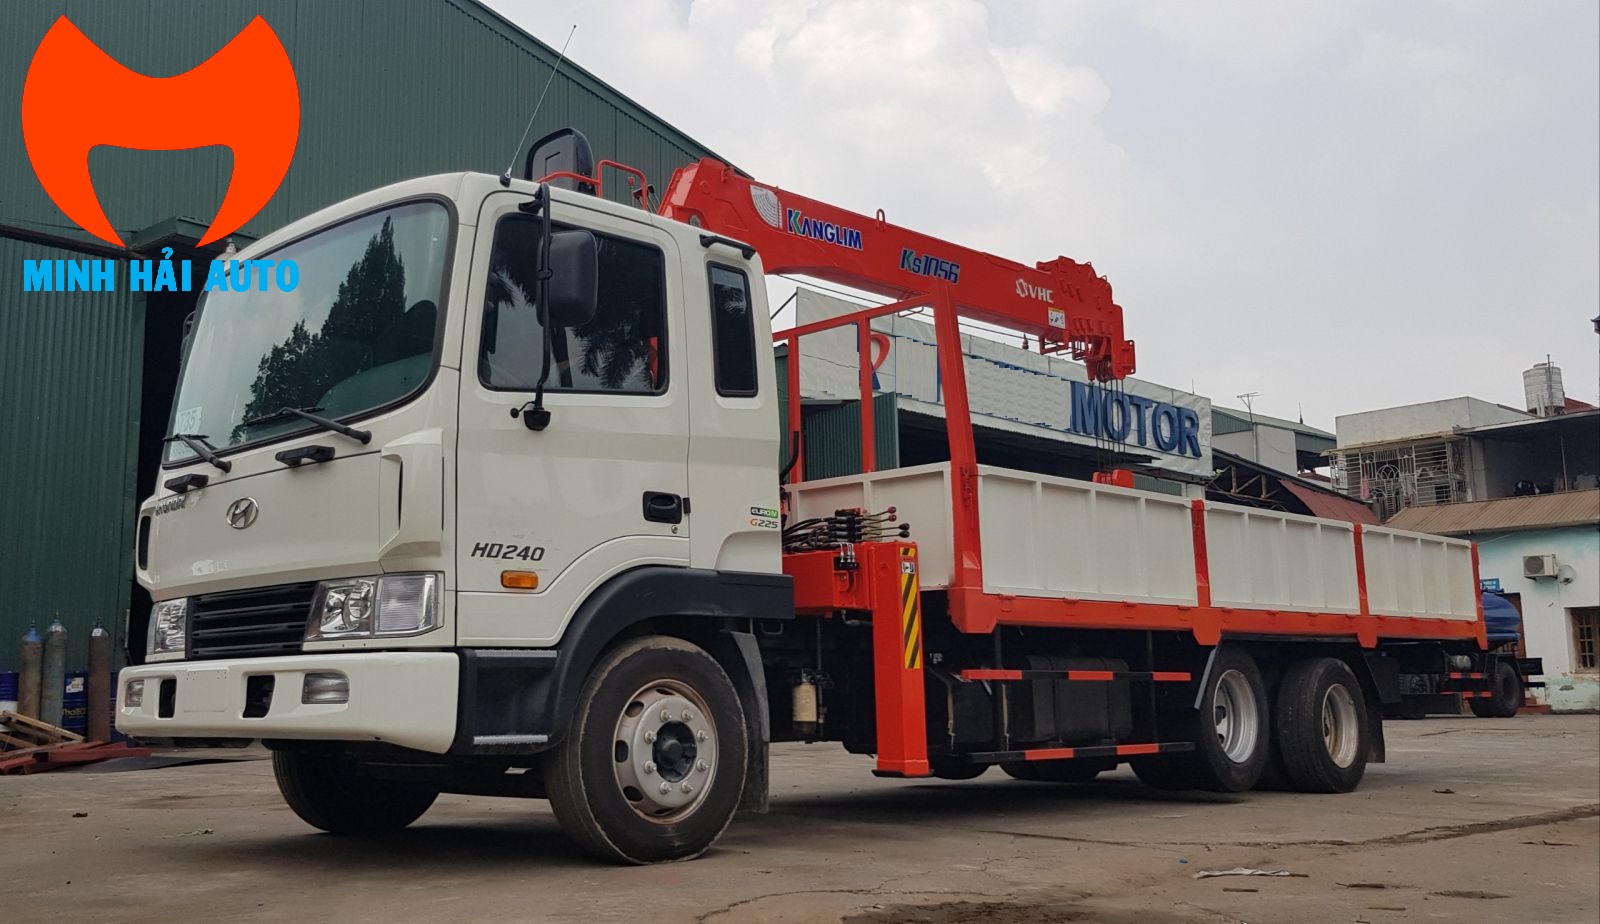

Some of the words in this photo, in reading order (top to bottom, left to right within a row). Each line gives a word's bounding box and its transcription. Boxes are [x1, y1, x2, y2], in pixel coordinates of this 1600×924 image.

[787, 208, 863, 251] KANGLIM
[1028, 284, 1054, 303] VHC
[1069, 380, 1202, 457] MOTOR
[750, 518, 778, 529] G225
[471, 542, 545, 561] HD240
